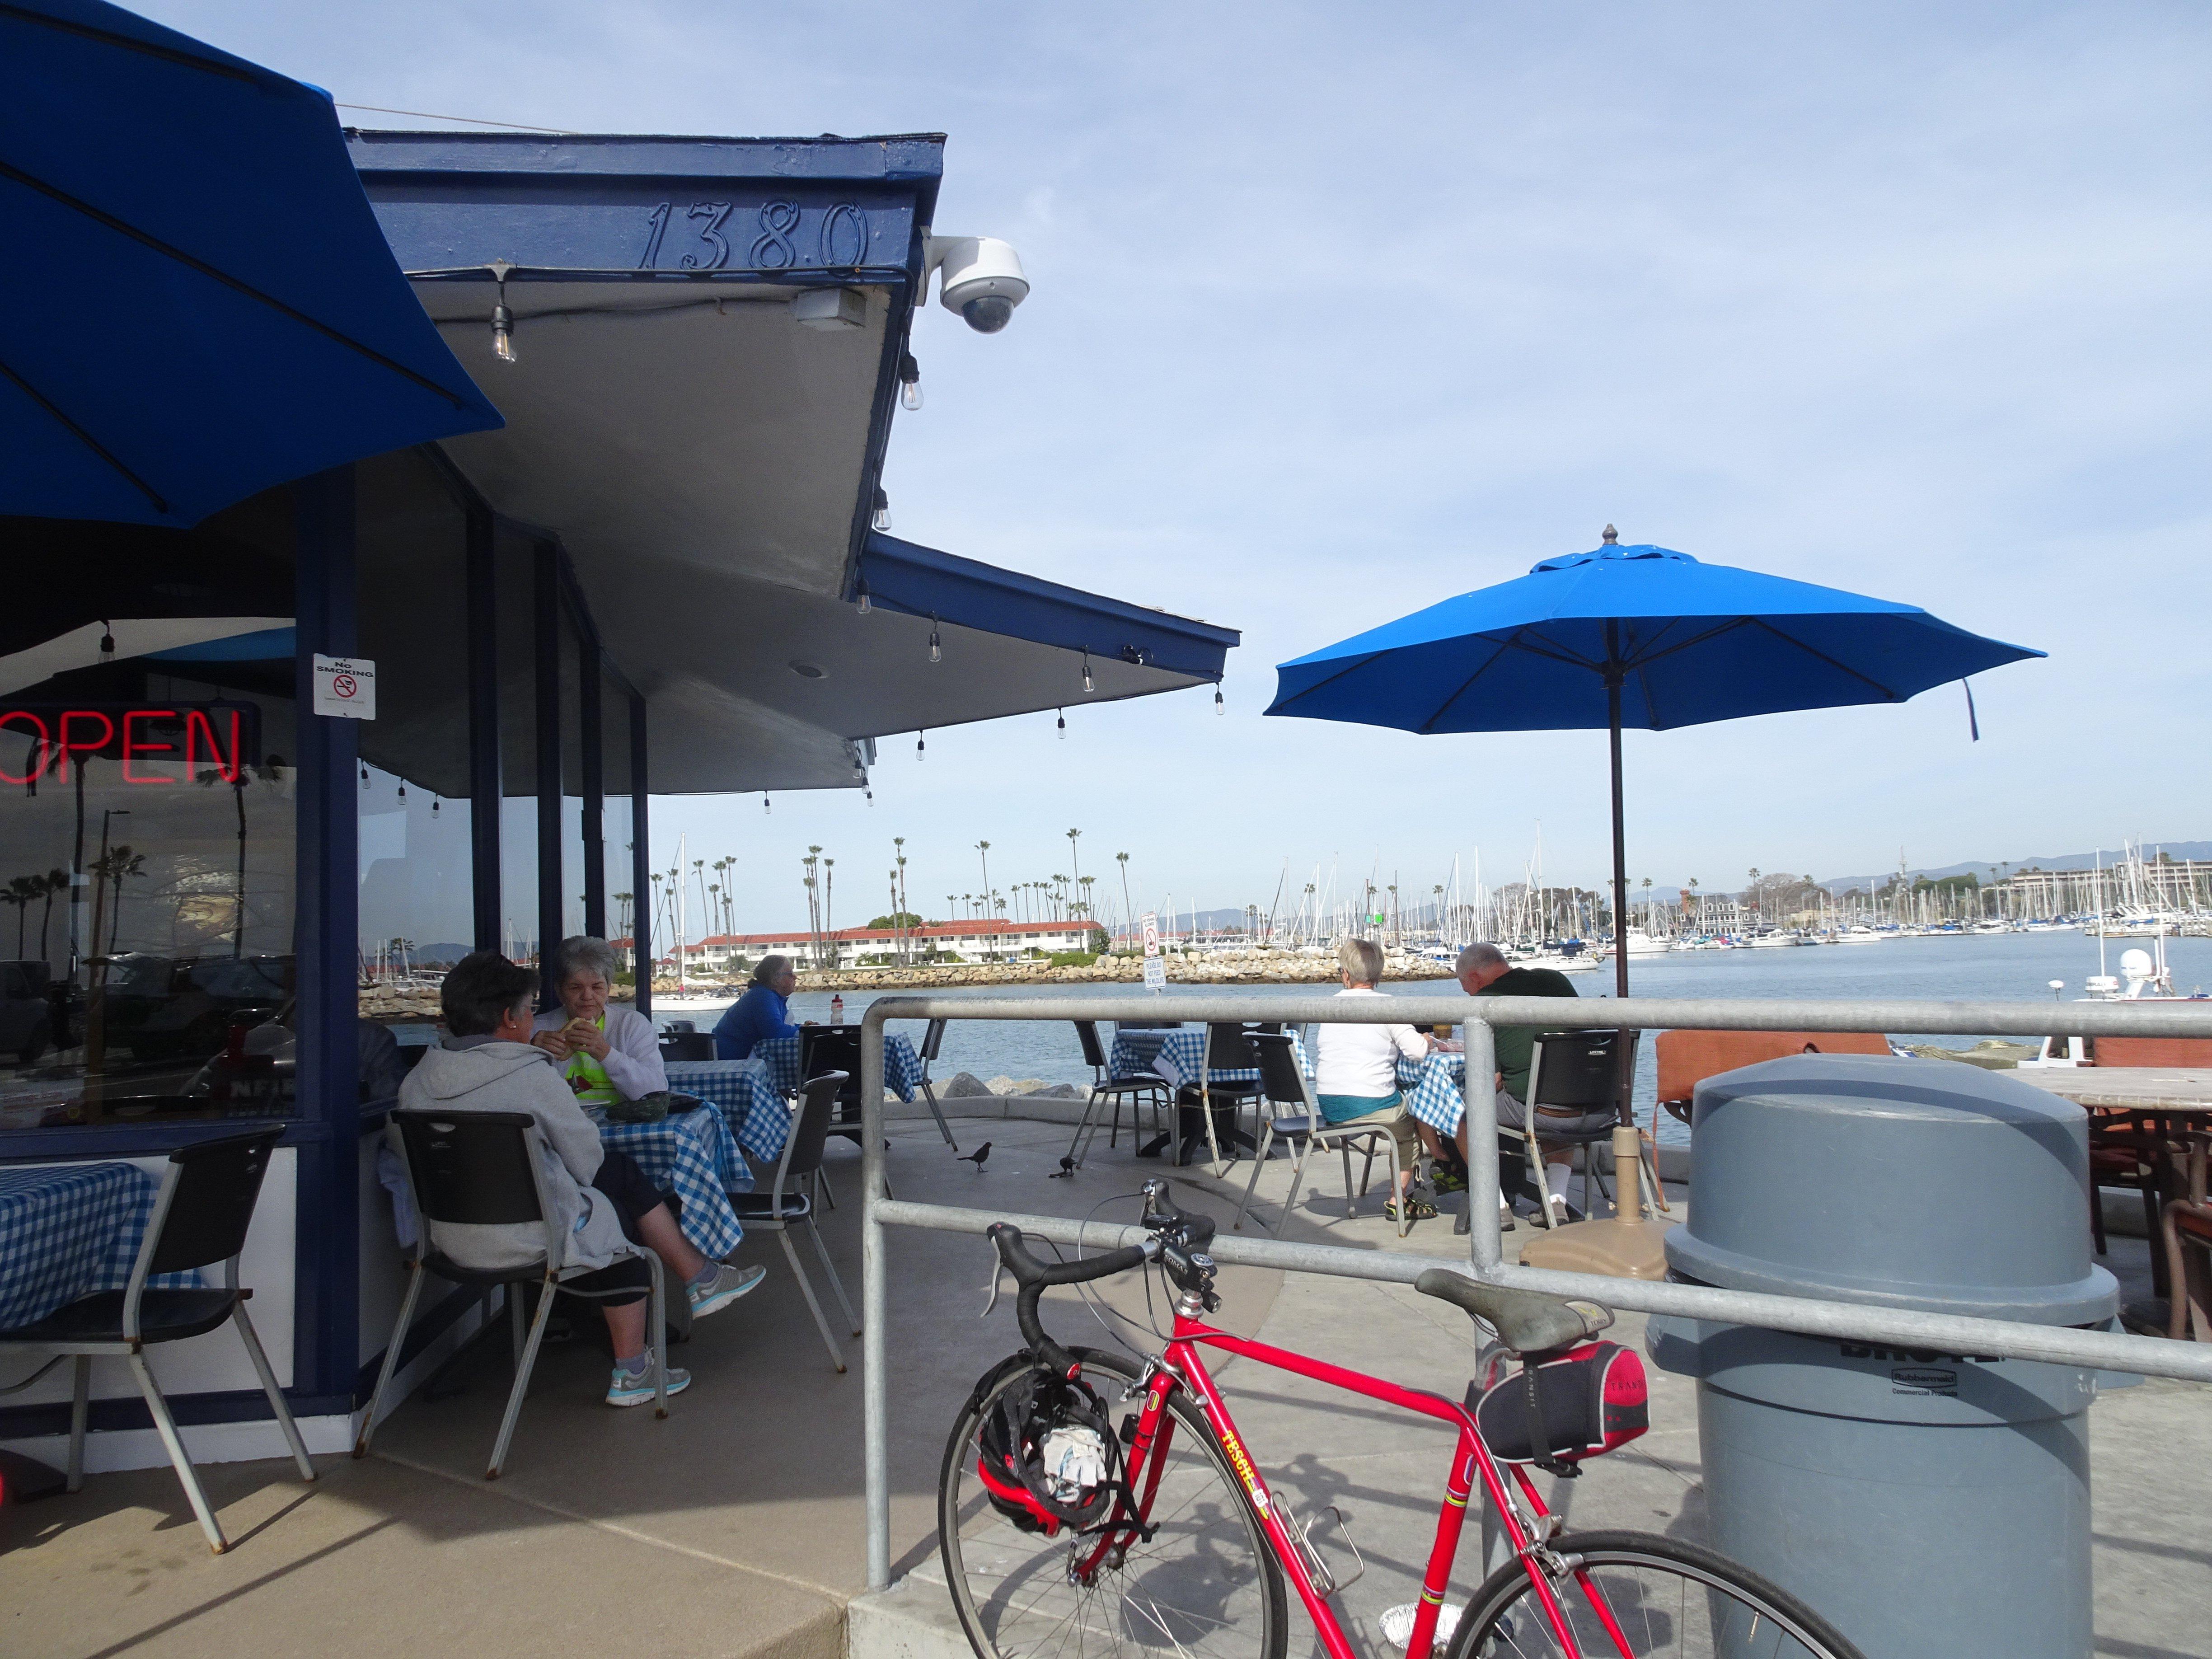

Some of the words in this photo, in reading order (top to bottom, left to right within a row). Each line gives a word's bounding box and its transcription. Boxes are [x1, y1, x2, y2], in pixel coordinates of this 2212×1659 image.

[637, 199, 869, 278] 1380
[316, 665, 374, 678] SMOKING
[0, 711, 240, 784] OPEN
[1894, 1373, 1954, 1382] Rubbermaid
[1892, 1387, 1930, 1396] Commercial
[1222, 1429, 1255, 1482] TESCH
[1254, 1491, 1265, 1504] 101
